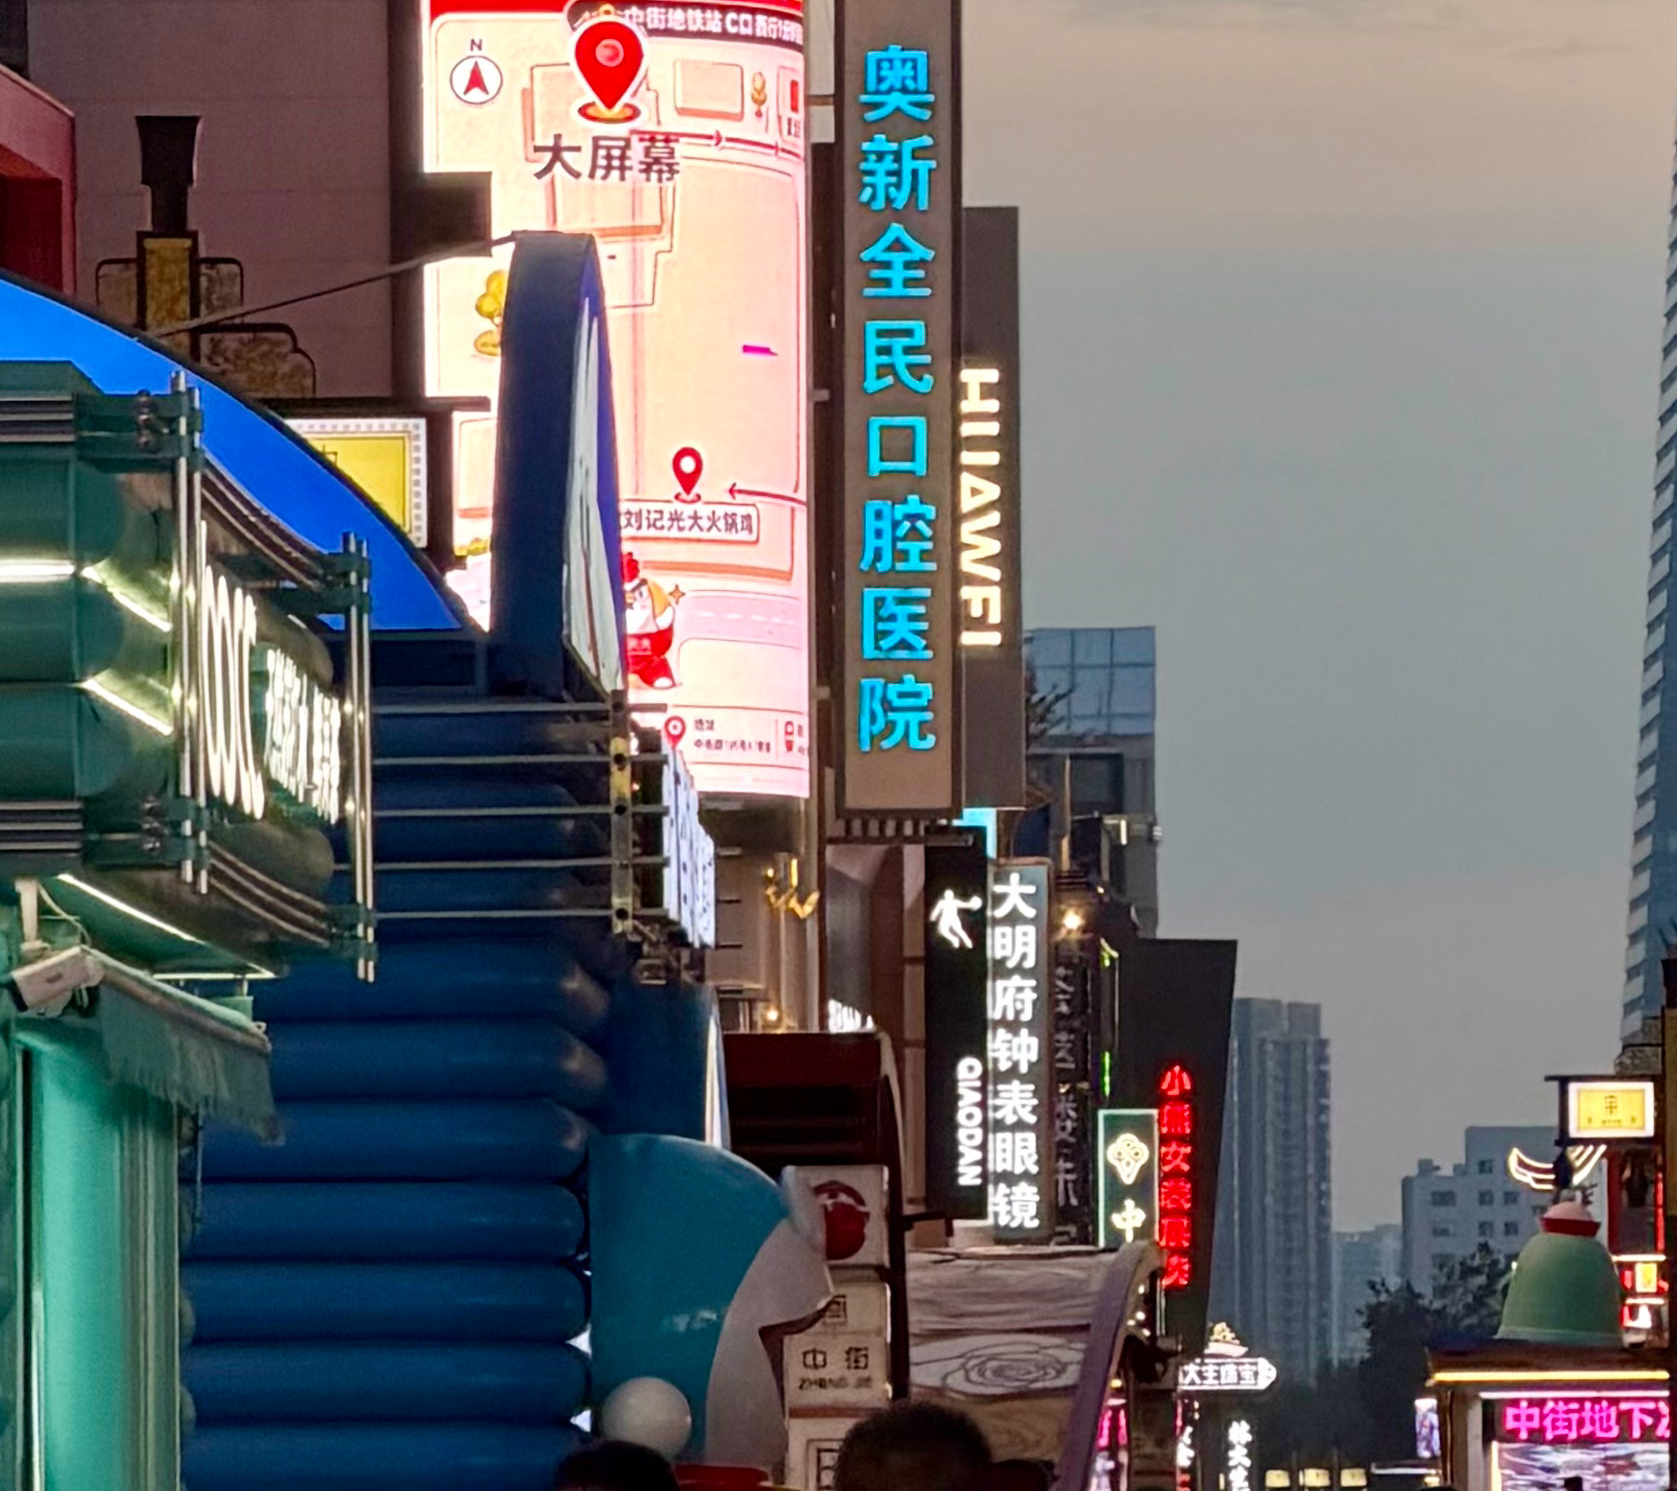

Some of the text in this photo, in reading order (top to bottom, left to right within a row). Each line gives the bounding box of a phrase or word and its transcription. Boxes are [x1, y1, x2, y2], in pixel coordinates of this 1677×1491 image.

[469, 38, 484, 51] N
[533, 133, 682, 184] 大屏幕
[857, 44, 938, 753] 奥新全民口腔医院
[959, 366, 1003, 648] HUAWEI
[991, 871, 1041, 1230] 大明府钟表眼镜
[956, 1055, 983, 1187] QIAODAN
[802, 1346, 869, 1371] 中街
